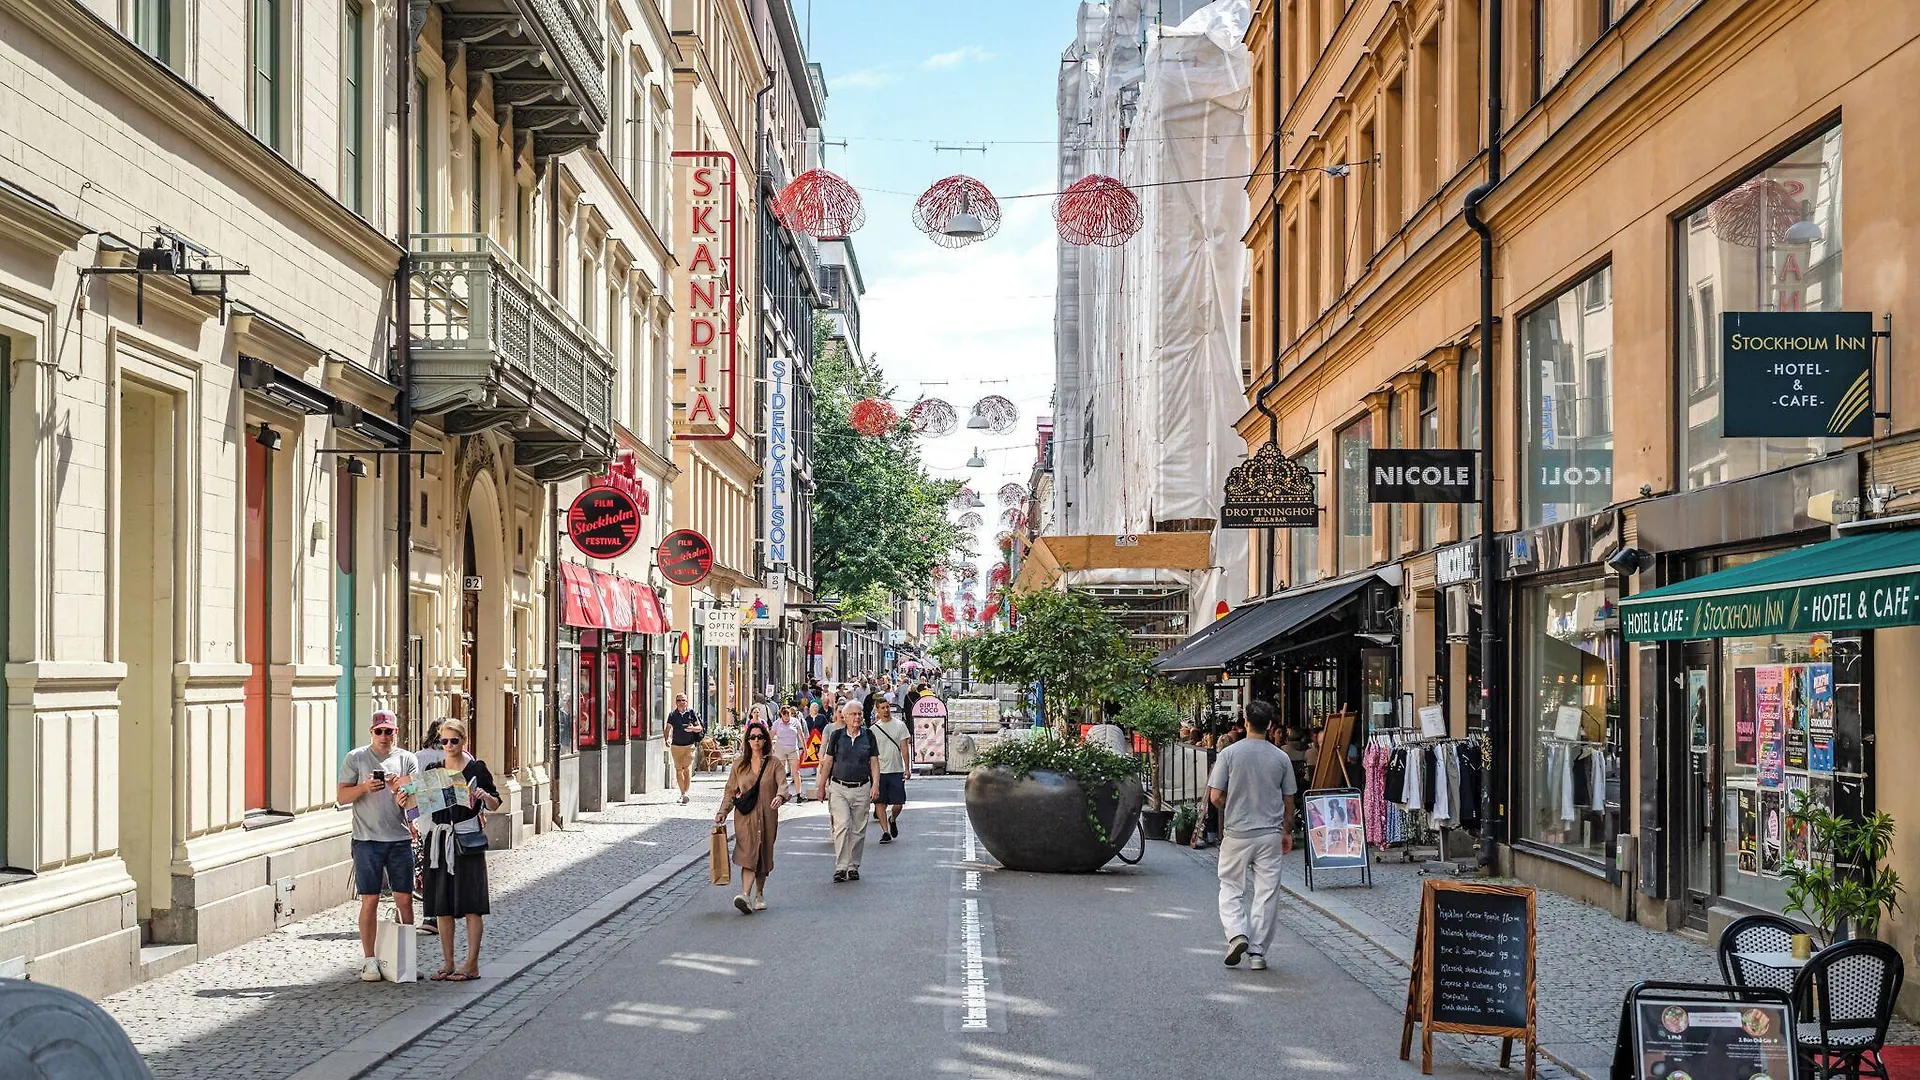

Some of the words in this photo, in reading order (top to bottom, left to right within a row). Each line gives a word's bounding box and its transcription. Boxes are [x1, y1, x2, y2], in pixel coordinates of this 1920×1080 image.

[689, 168, 717, 422] SKANDIA
[1731, 333, 1828, 350] STOCKHOLM
[1835, 334, 1866, 350] INN
[1793, 379, 1803, 391] &
[771, 360, 786, 561] SIDENCARLSON
[1375, 466, 1469, 486] NICOLE
[594, 499, 614, 507] FILM
[1225, 507, 1315, 517] DROTTNINGHOF
[573, 509, 635, 536] Stockholm
[585, 537, 622, 547] FESTIVAL
[1436, 544, 1474, 584] NICOLE
[465, 579, 479, 588] 82
[1628, 613, 1652, 634] HOTEL
[1653, 612, 1659, 632] &
[1661, 609, 1683, 631] CAFE
[1703, 602, 1761, 631] STOCKHOLM
[1764, 600, 1784, 627] INN
[1812, 592, 1852, 622] HOTEL
[1857, 590, 1868, 619] &
[1873, 586, 1911, 618] CAFE
[709, 612, 737, 620] CITY
[709, 622, 735, 630] OPTIK
[1499, 950, 1509, 960] 95
[1497, 983, 1508, 993] 95
